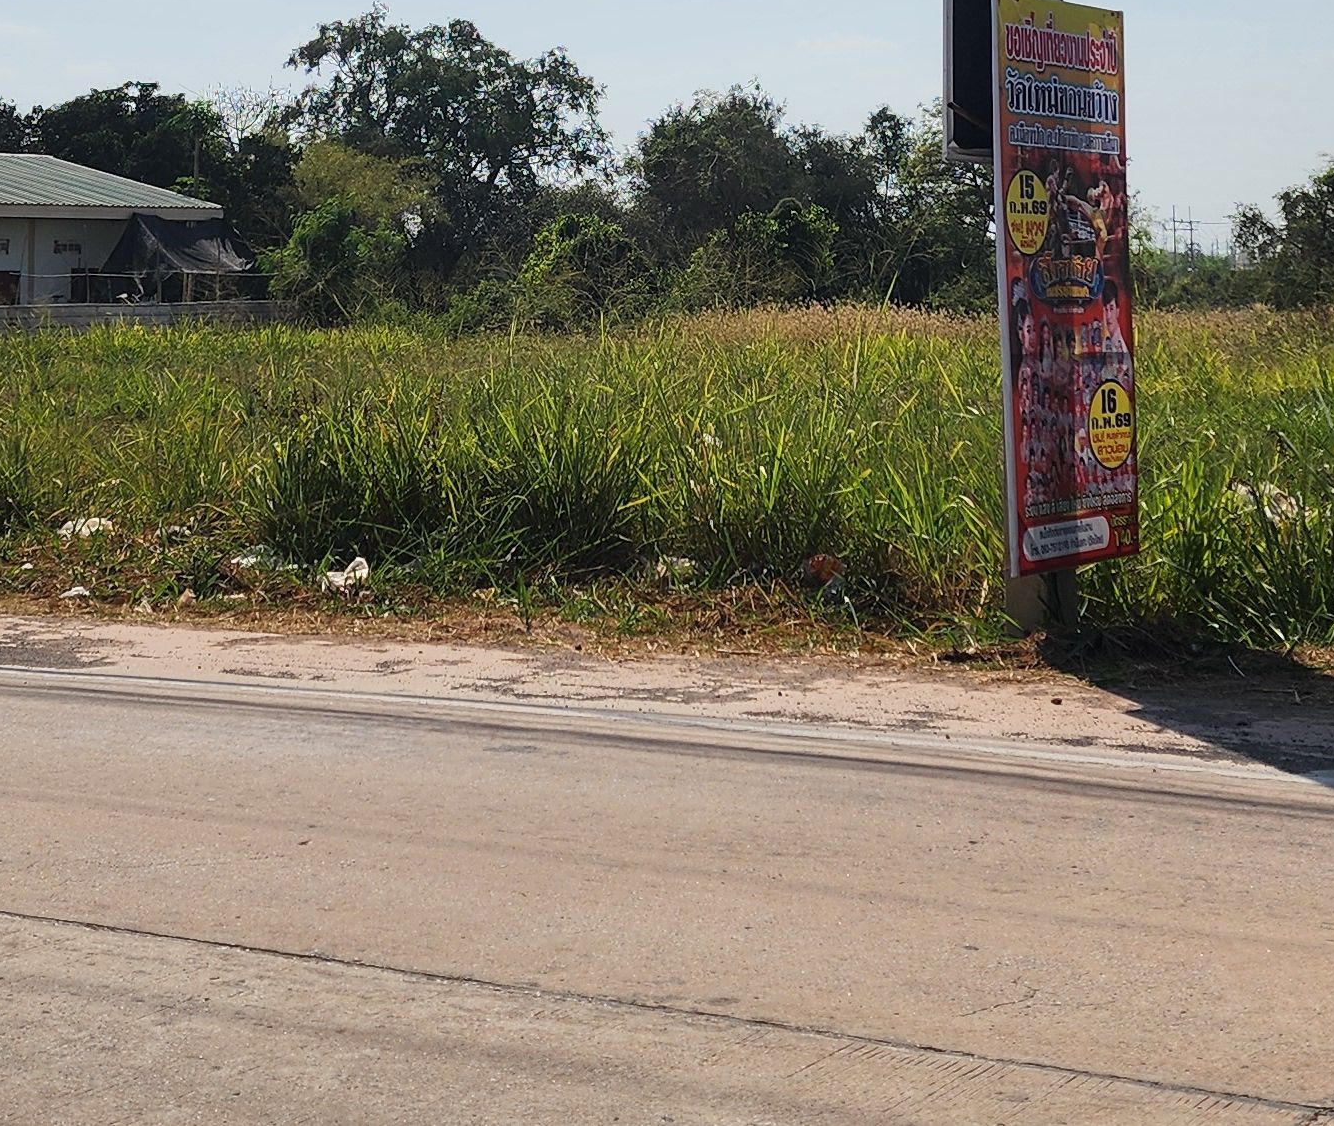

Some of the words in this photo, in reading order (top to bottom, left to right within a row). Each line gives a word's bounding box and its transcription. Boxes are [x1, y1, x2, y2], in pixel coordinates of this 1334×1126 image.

[1019, 174, 1035, 200] 15
[1009, 200, 1047, 215] ก.พ.69
[1101, 388, 1117, 414] 16
[1091, 413, 1131, 430] ก.พ.69
